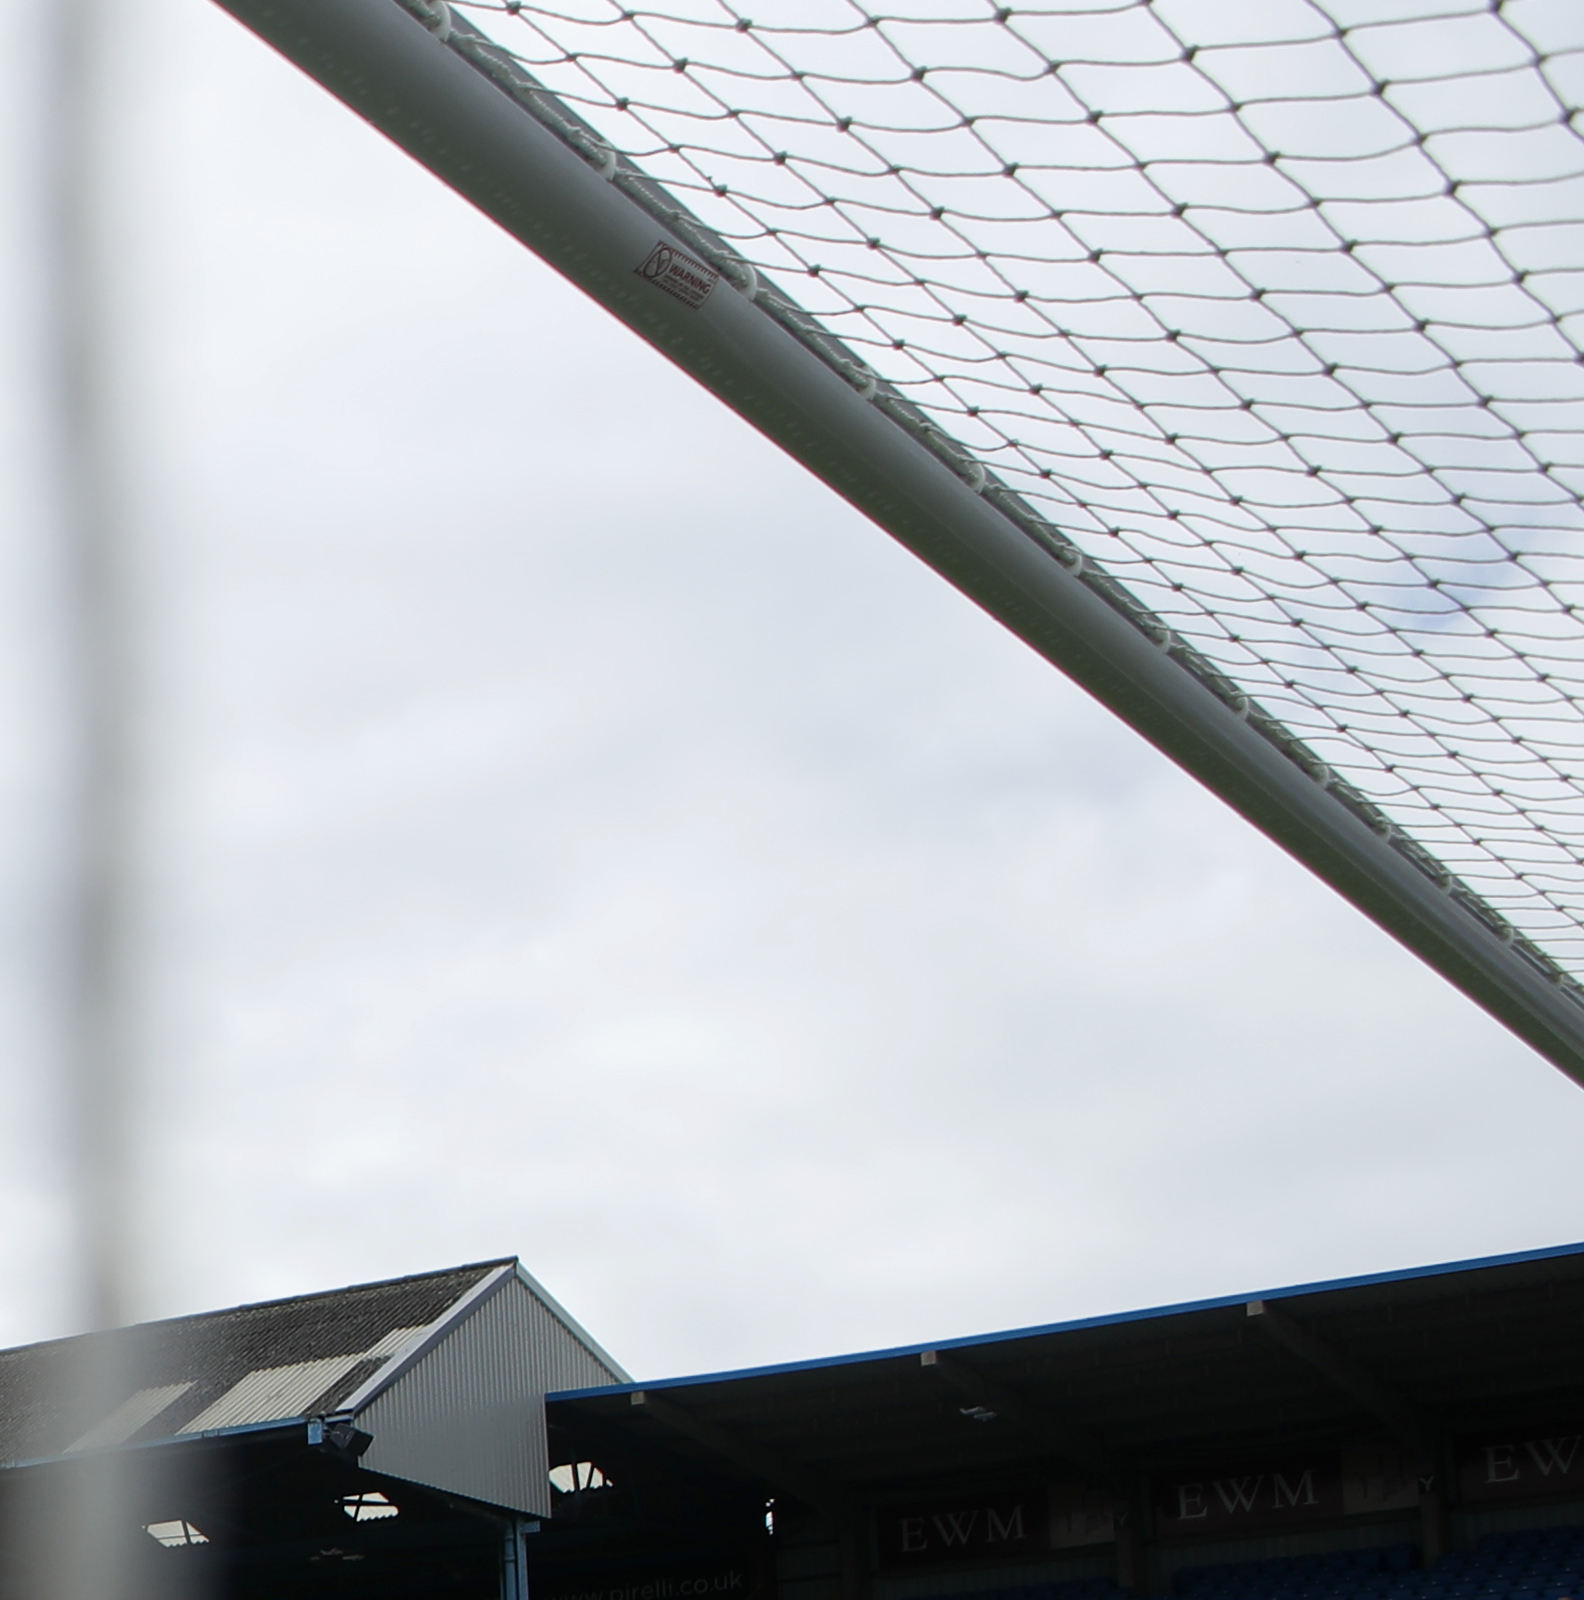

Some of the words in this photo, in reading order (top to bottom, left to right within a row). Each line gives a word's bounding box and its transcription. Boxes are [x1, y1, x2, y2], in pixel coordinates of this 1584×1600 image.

[669, 264, 712, 294] WARNING
[1175, 1468, 1321, 1522] EWM
[899, 1505, 1027, 1553] EWM
